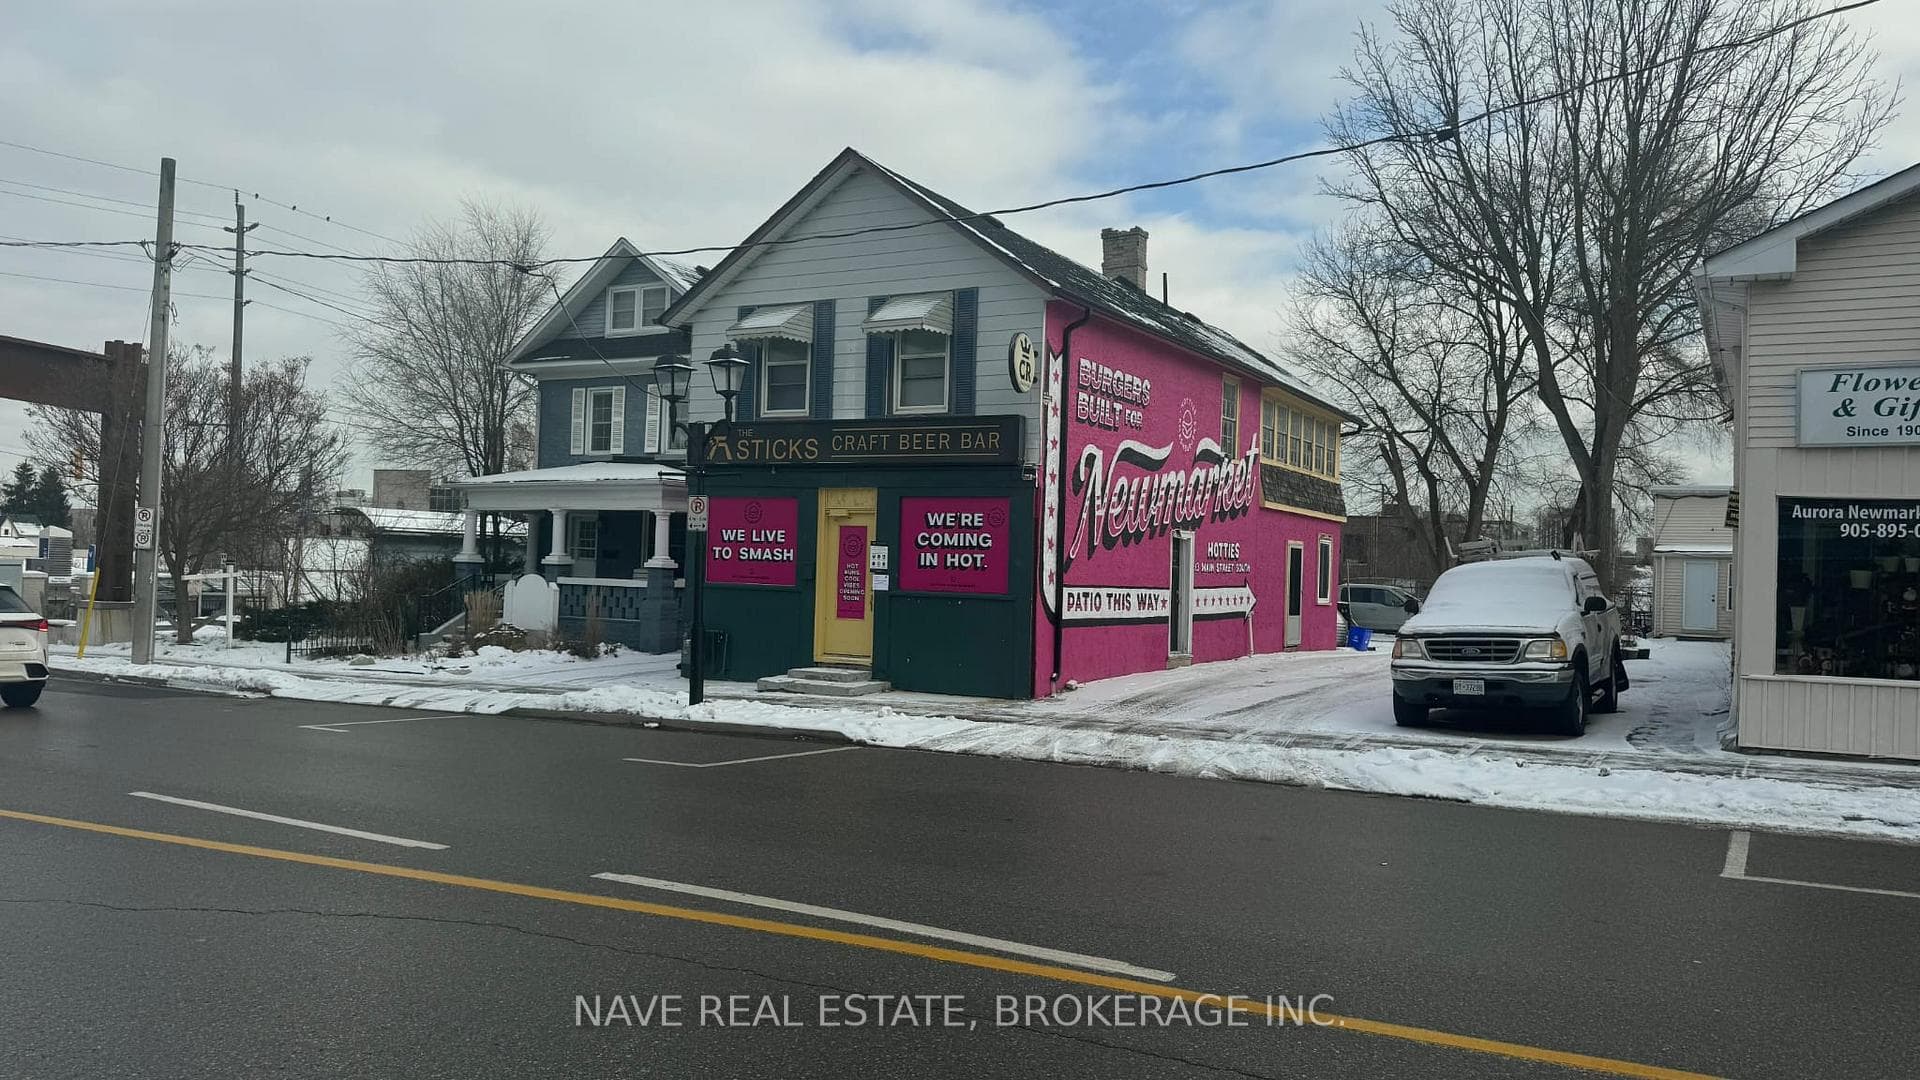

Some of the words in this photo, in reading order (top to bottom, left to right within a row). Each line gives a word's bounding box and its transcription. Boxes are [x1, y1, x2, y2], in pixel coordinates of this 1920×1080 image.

[1079, 357, 1151, 408] BURGERS
[1826, 372, 1920, 393] Flowe
[1077, 391, 1123, 429] BUILT
[1125, 408, 1143, 429] FOR
[1832, 397, 1858, 418] &
[737, 428, 754, 438] THE
[1846, 425, 1890, 437] Since
[736, 438, 819, 460] STICKS
[831, 434, 890, 451] CRAFT
[899, 433, 951, 450] BEER
[960, 431, 1000, 449] BAR
[1068, 433, 1260, 562] Newmarket
[926, 512, 985, 528] WE'RE
[1791, 504, 1844, 520] Aurora
[721, 529, 746, 542] WE
[751, 529, 786, 543] LIVE
[916, 532, 993, 549] COMING
[712, 546, 732, 560] TO
[738, 547, 794, 562] SMASH
[1206, 541, 1241, 560] HOTTIES
[919, 552, 939, 567] IN
[945, 553, 989, 569] HOT.
[1215, 562, 1235, 574] STREET
[1066, 591, 1102, 612] PATIO
[1106, 592, 1132, 612] THIS
[1136, 593, 1160, 611] WAY
